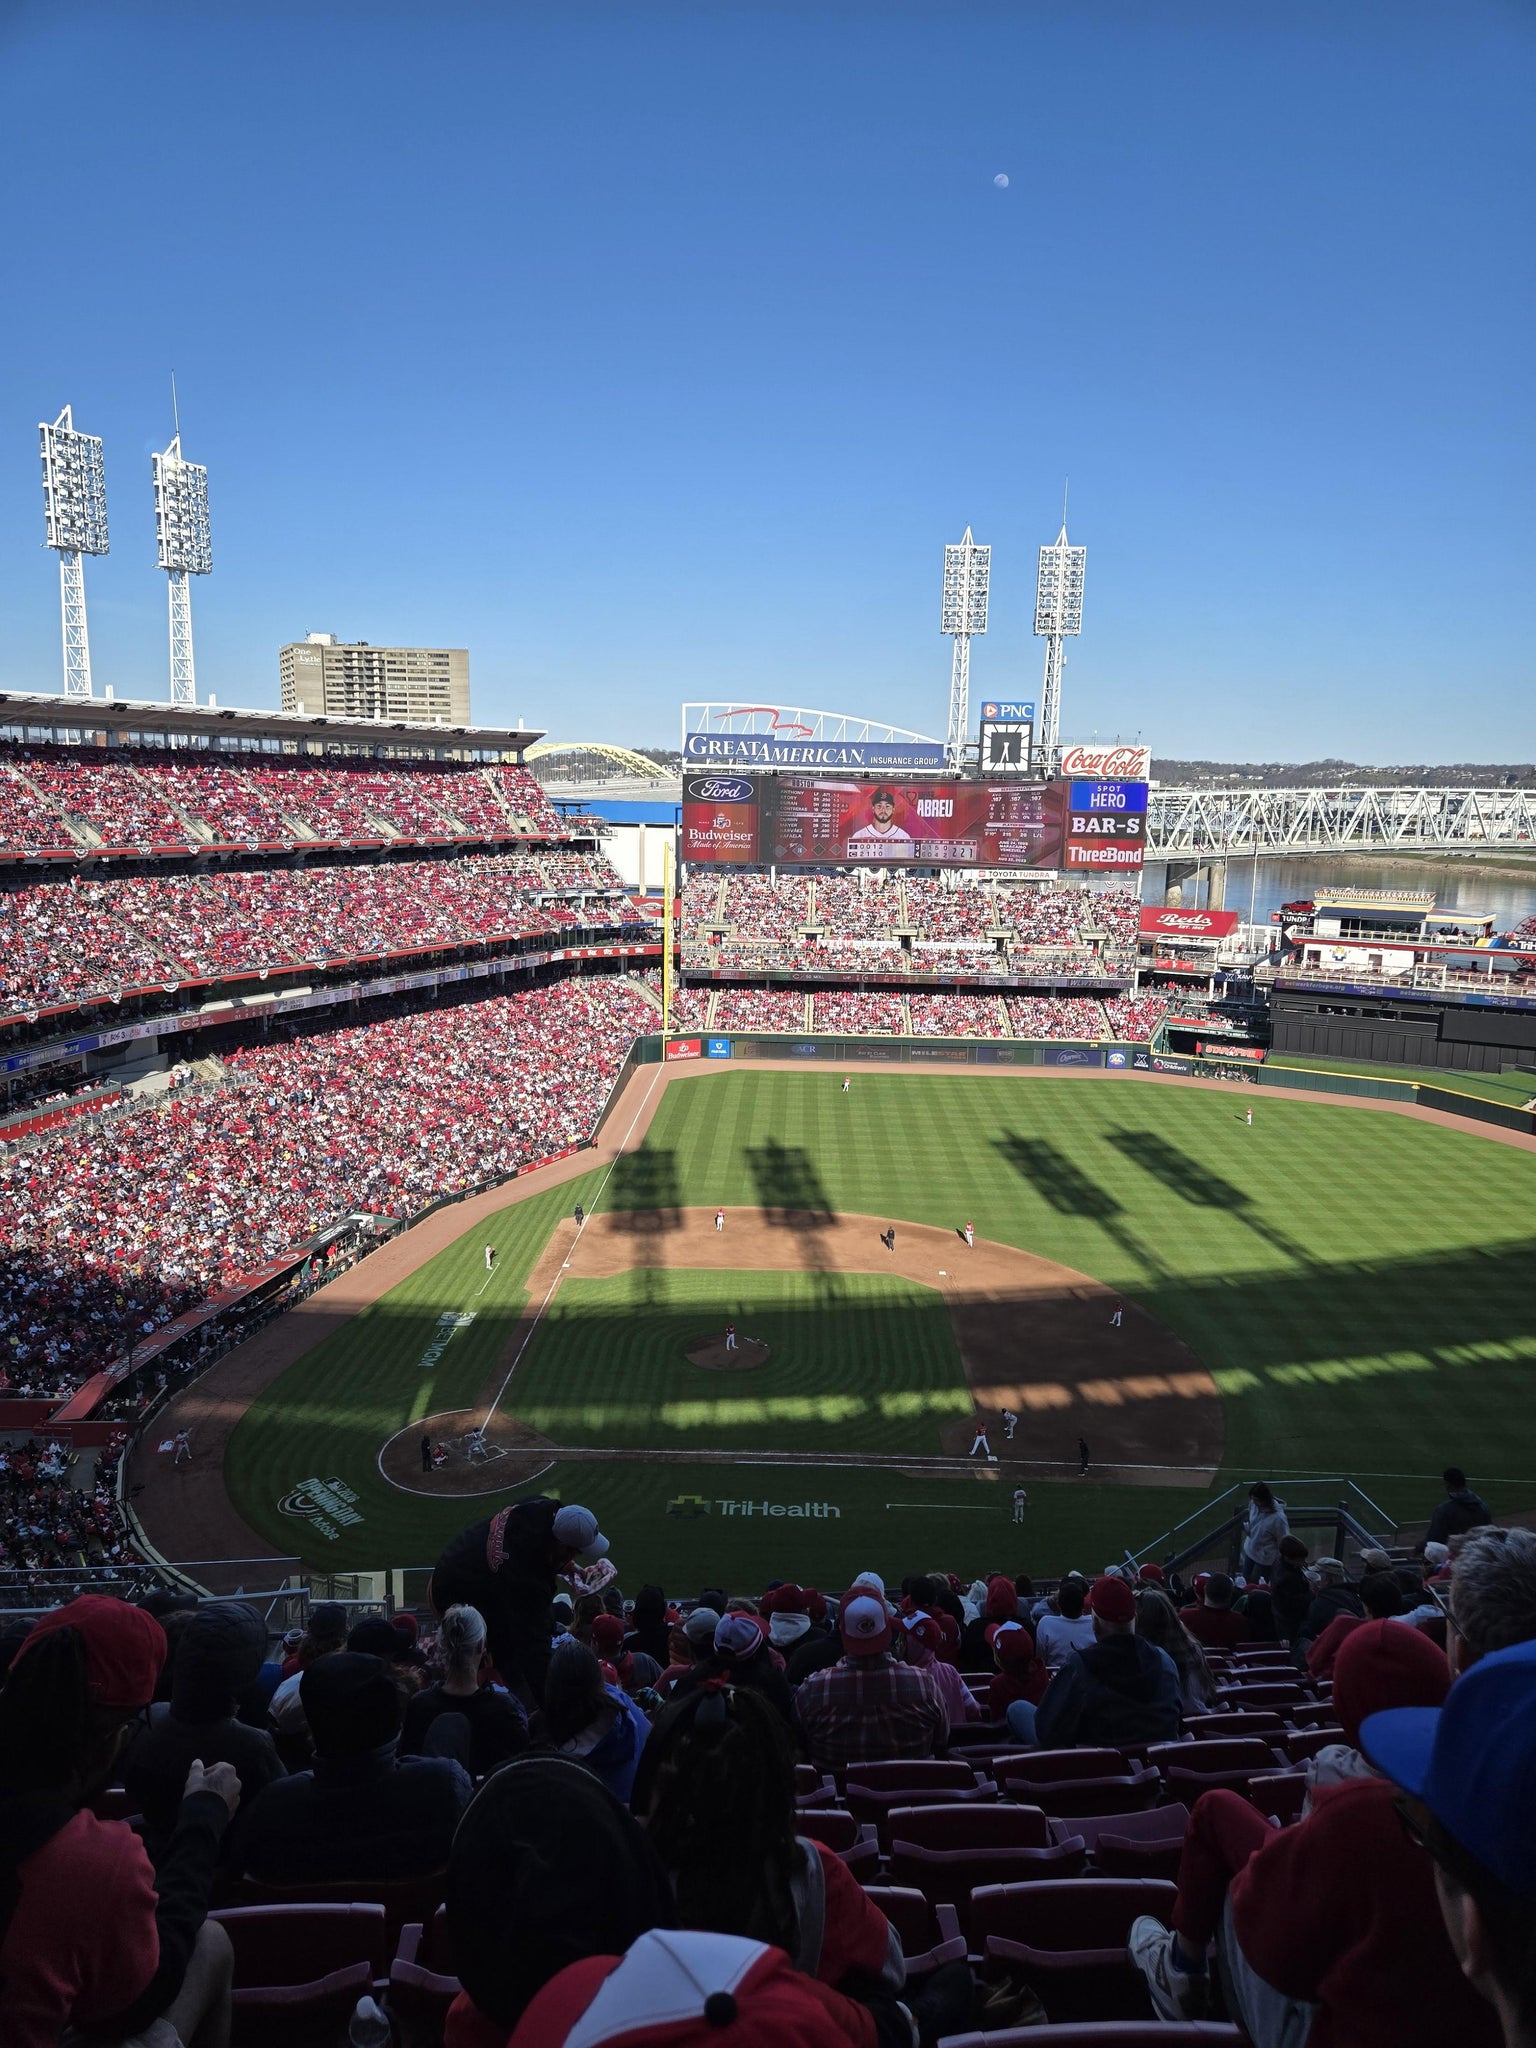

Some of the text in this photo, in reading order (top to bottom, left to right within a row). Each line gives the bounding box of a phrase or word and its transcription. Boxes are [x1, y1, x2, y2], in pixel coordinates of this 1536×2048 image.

[1000, 705, 1032, 718] PNC
[688, 736, 762, 756] GREAT
[870, 756, 912, 765] INSURANCE
[914, 757, 939, 765] GROUP
[1062, 747, 1149, 776] Coca-Cola
[701, 780, 741, 798] Ford
[917, 799, 953, 818] ABREU
[1090, 793, 1126, 808] HERO
[1071, 817, 1140, 834] BAR-S
[688, 828, 753, 841] Budweiser
[687, 840, 751, 849] Made of America
[1068, 846, 1142, 863] ThreeBond
[1156, 913, 1212, 927] Reds
[668, 1051, 700, 1060] Budweiser
[295, 1478, 365, 1527] OPENING DAY
[715, 1500, 841, 1518] TriHealth
[308, 1515, 340, 1541] Adobe
